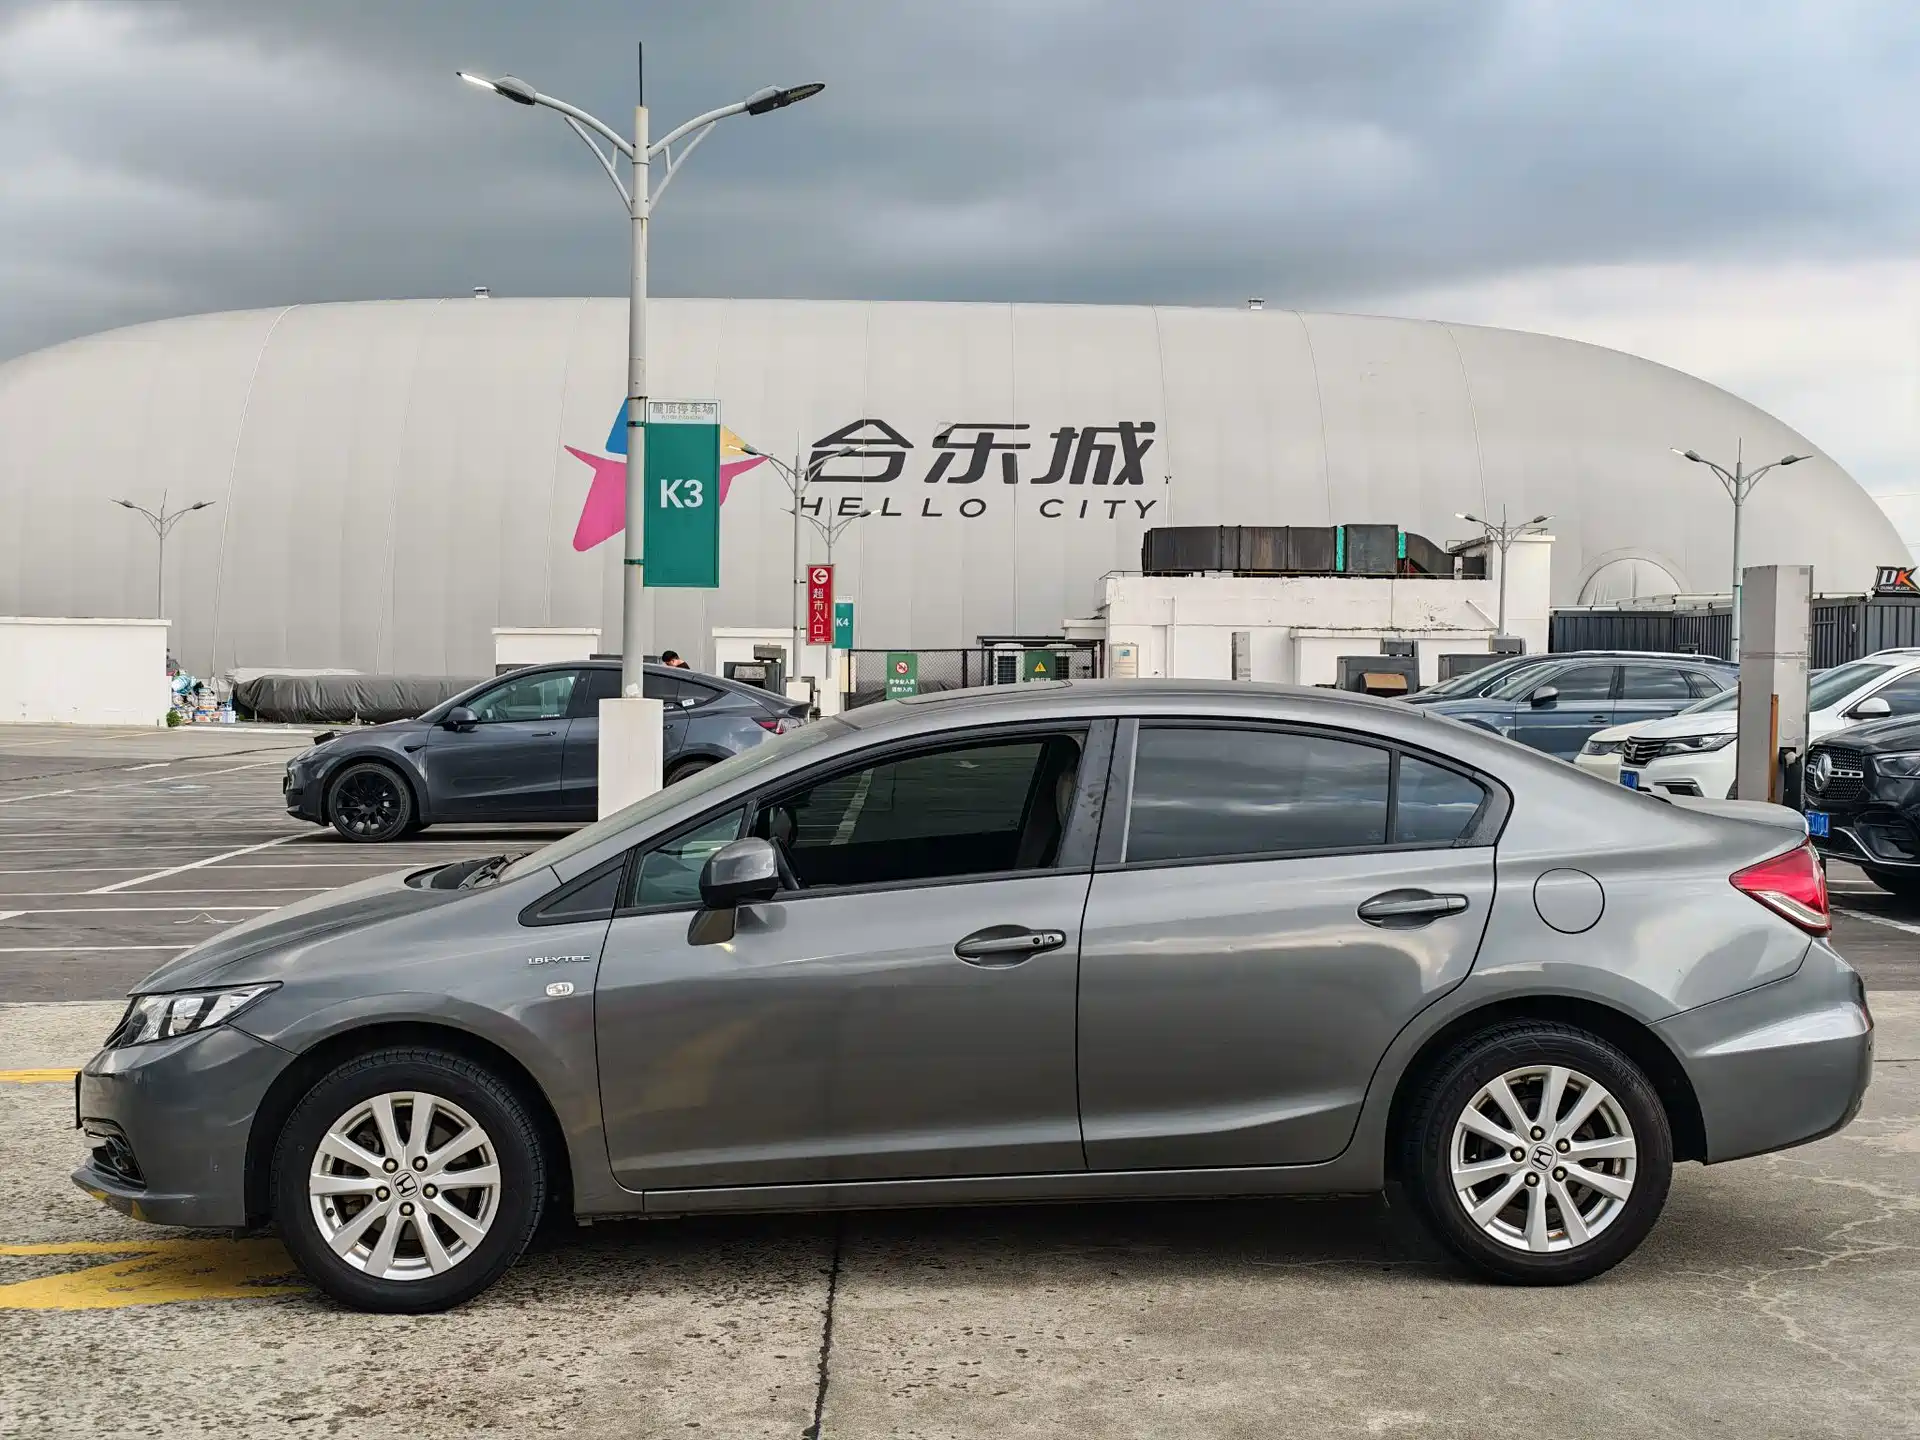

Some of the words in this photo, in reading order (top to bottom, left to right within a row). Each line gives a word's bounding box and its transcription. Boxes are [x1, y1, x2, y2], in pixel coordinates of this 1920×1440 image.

[804, 418, 1156, 486] 合乐城
[660, 479, 704, 508] K3
[800, 496, 987, 518] HELLO
[1040, 498, 1157, 519] CITY
[812, 587, 825, 634] 超市入口
[836, 617, 850, 627] K4
